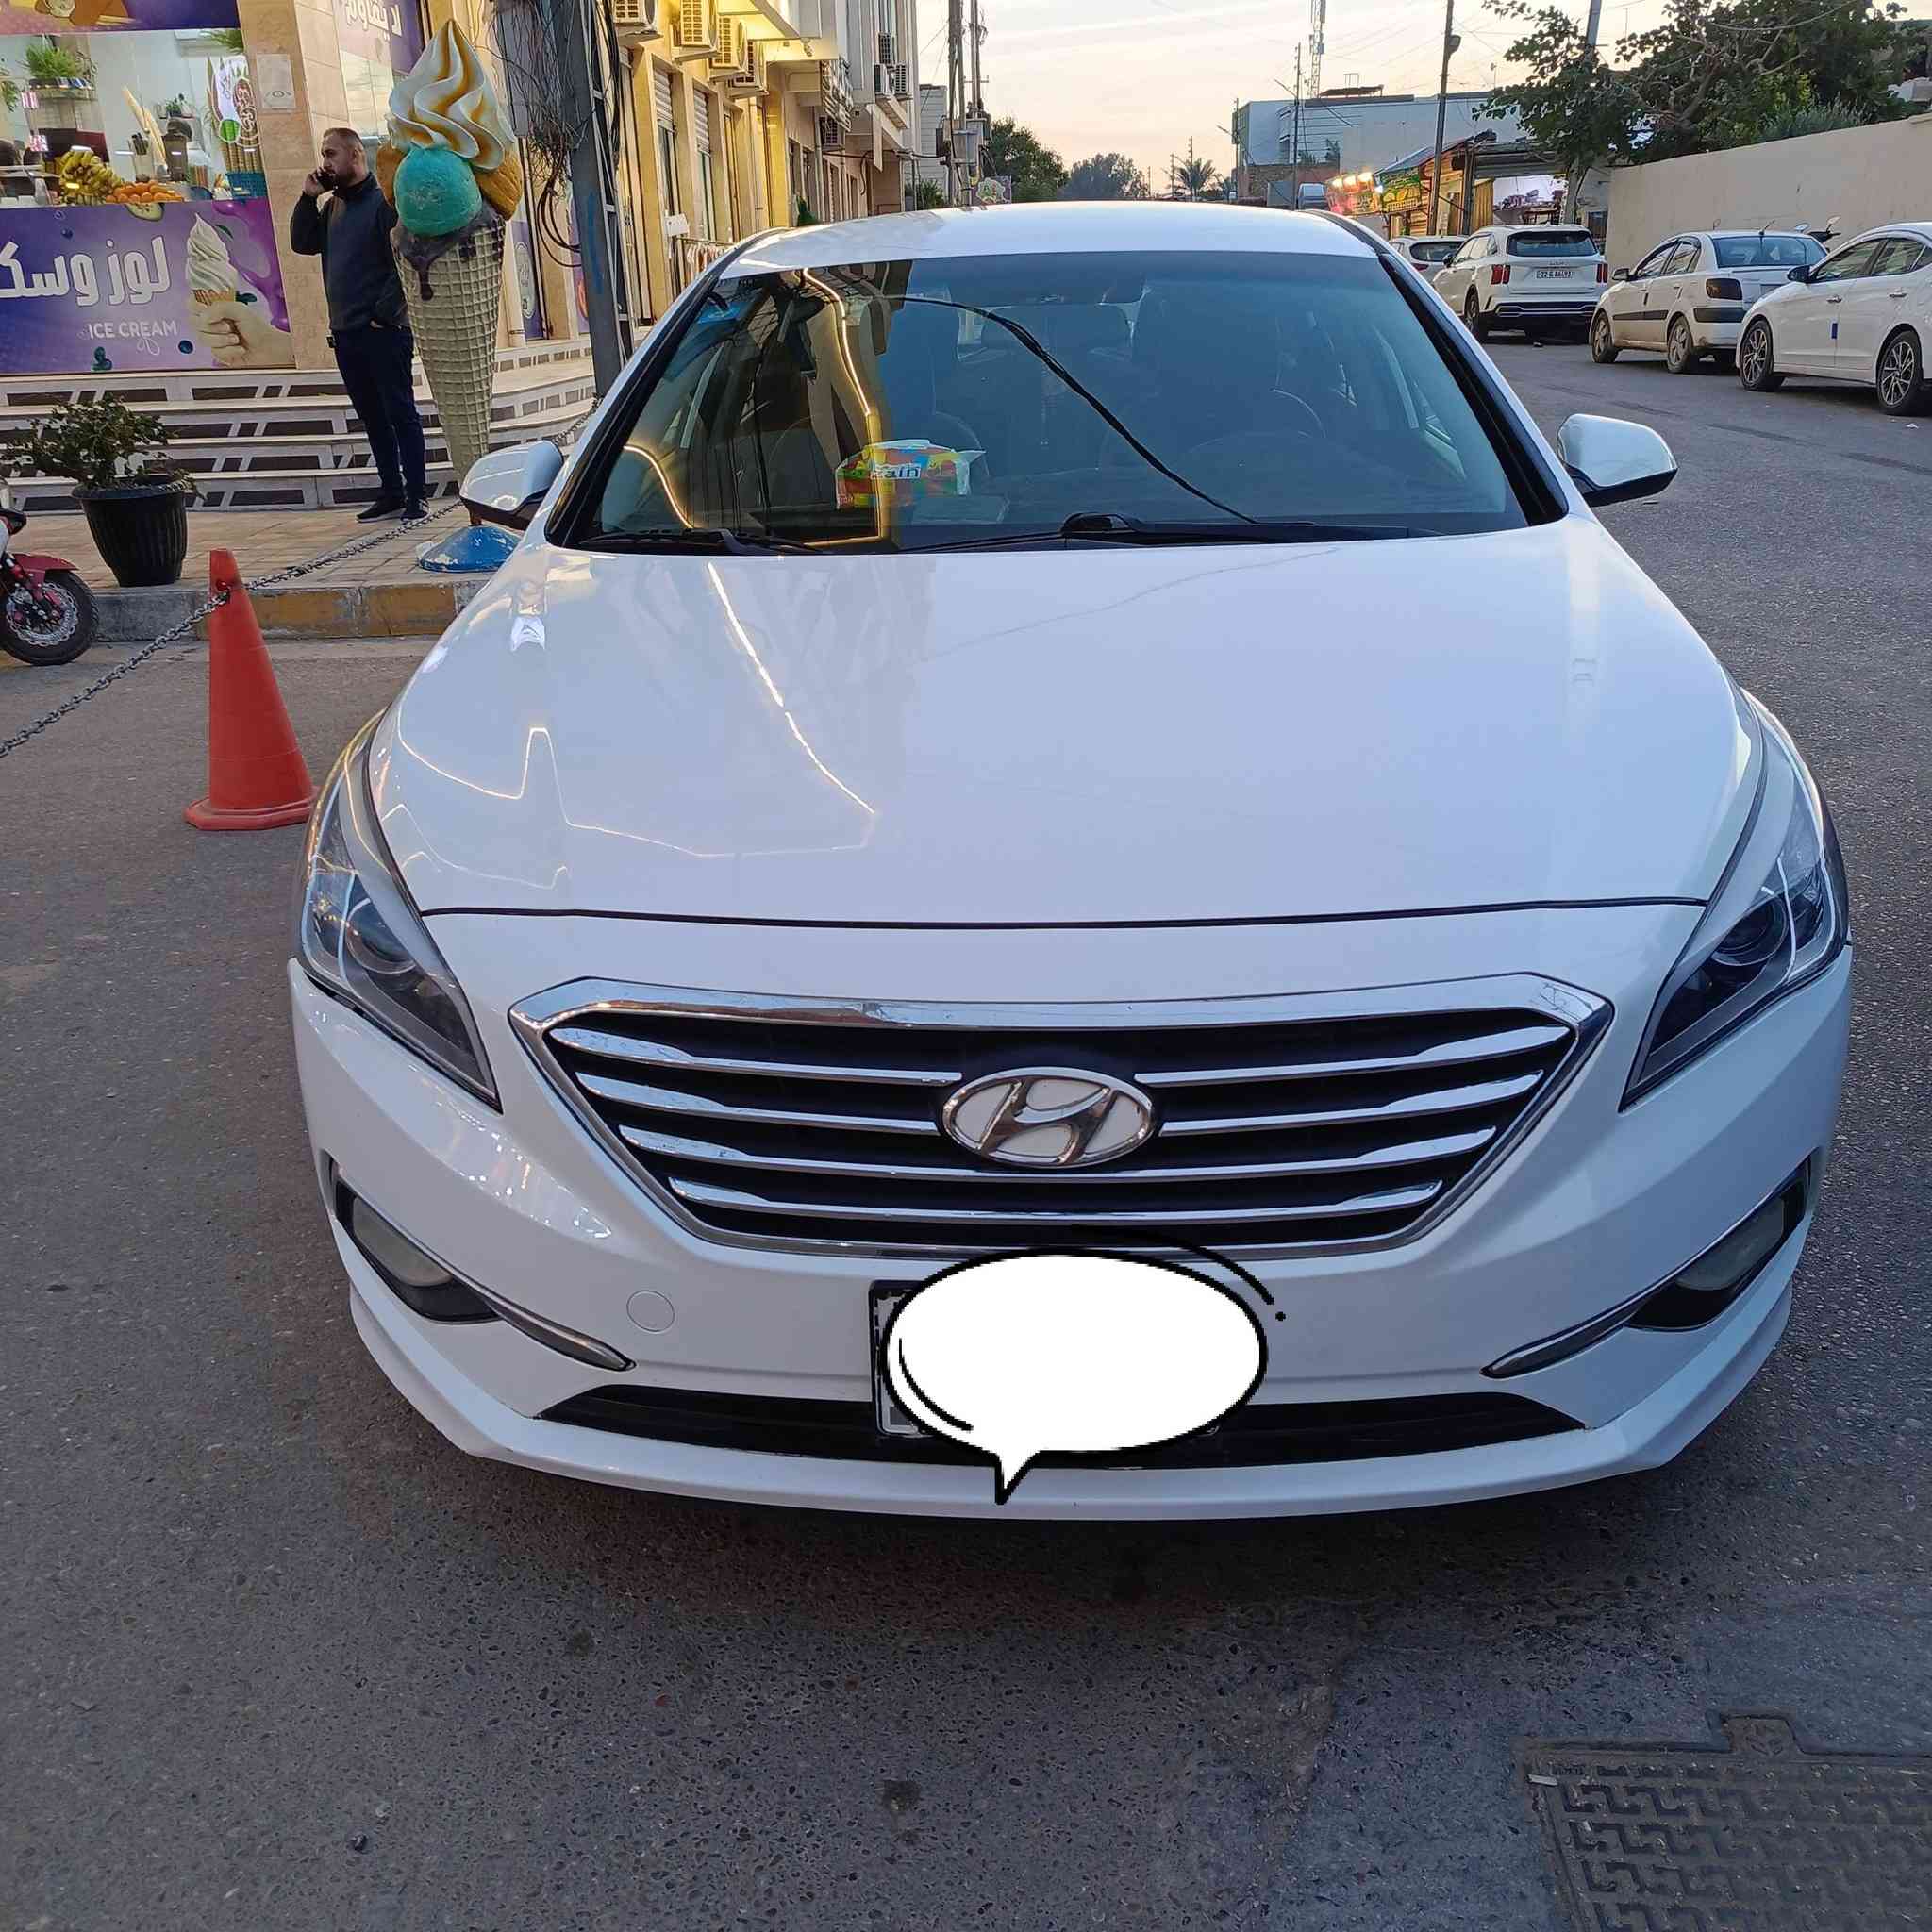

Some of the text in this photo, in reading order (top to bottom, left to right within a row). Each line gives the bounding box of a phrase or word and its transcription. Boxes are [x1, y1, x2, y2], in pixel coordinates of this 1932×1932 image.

[0, 236, 171, 307] لوز وسك
[87, 319, 178, 340] ICE CREAM
